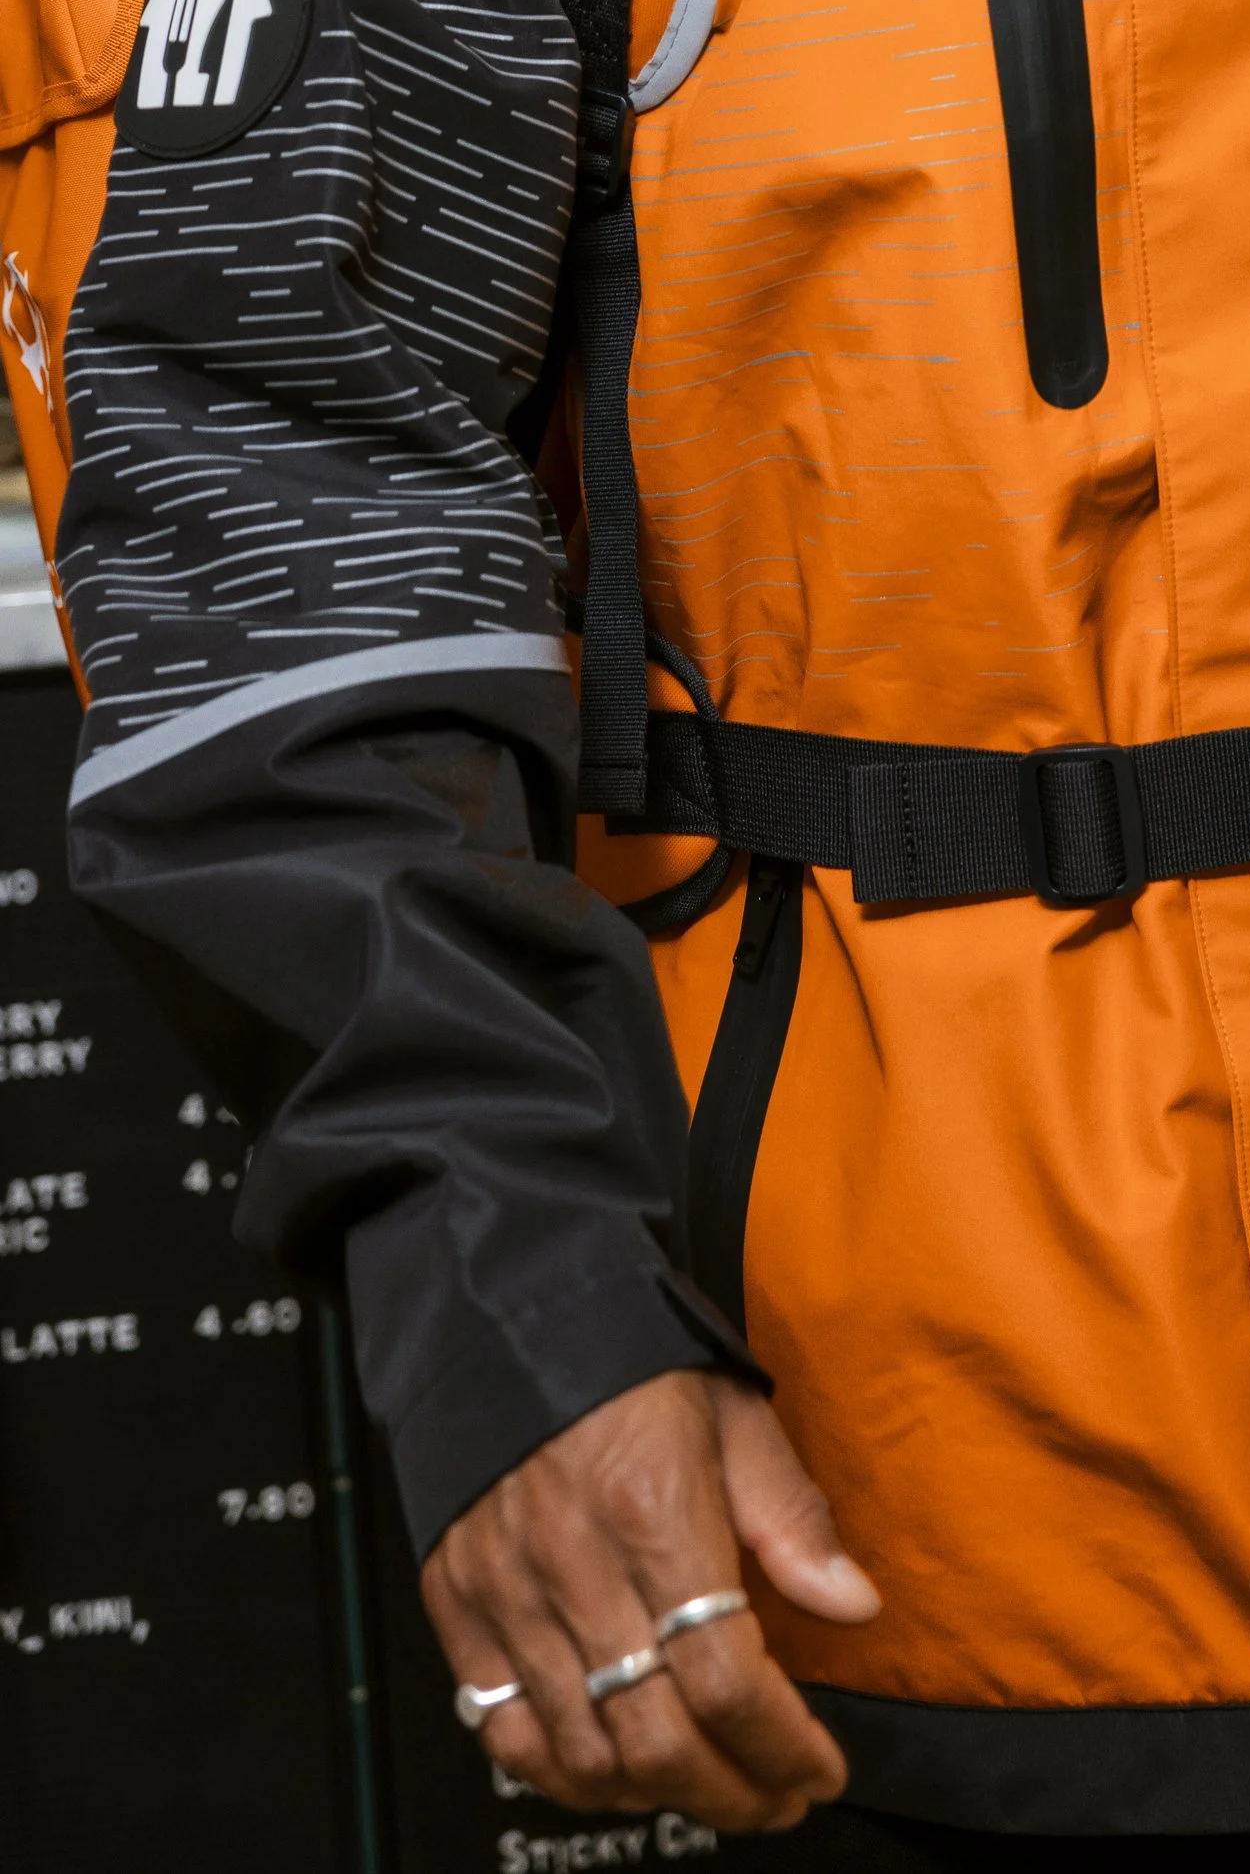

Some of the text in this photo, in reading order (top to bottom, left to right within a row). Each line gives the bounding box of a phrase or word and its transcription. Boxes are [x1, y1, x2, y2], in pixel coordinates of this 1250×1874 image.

[0, 999, 62, 1040] RY
[0, 1037, 93, 1080] RRY
[0, 1172, 88, 1214] ATE
[2, 1313, 140, 1363] LATTE
